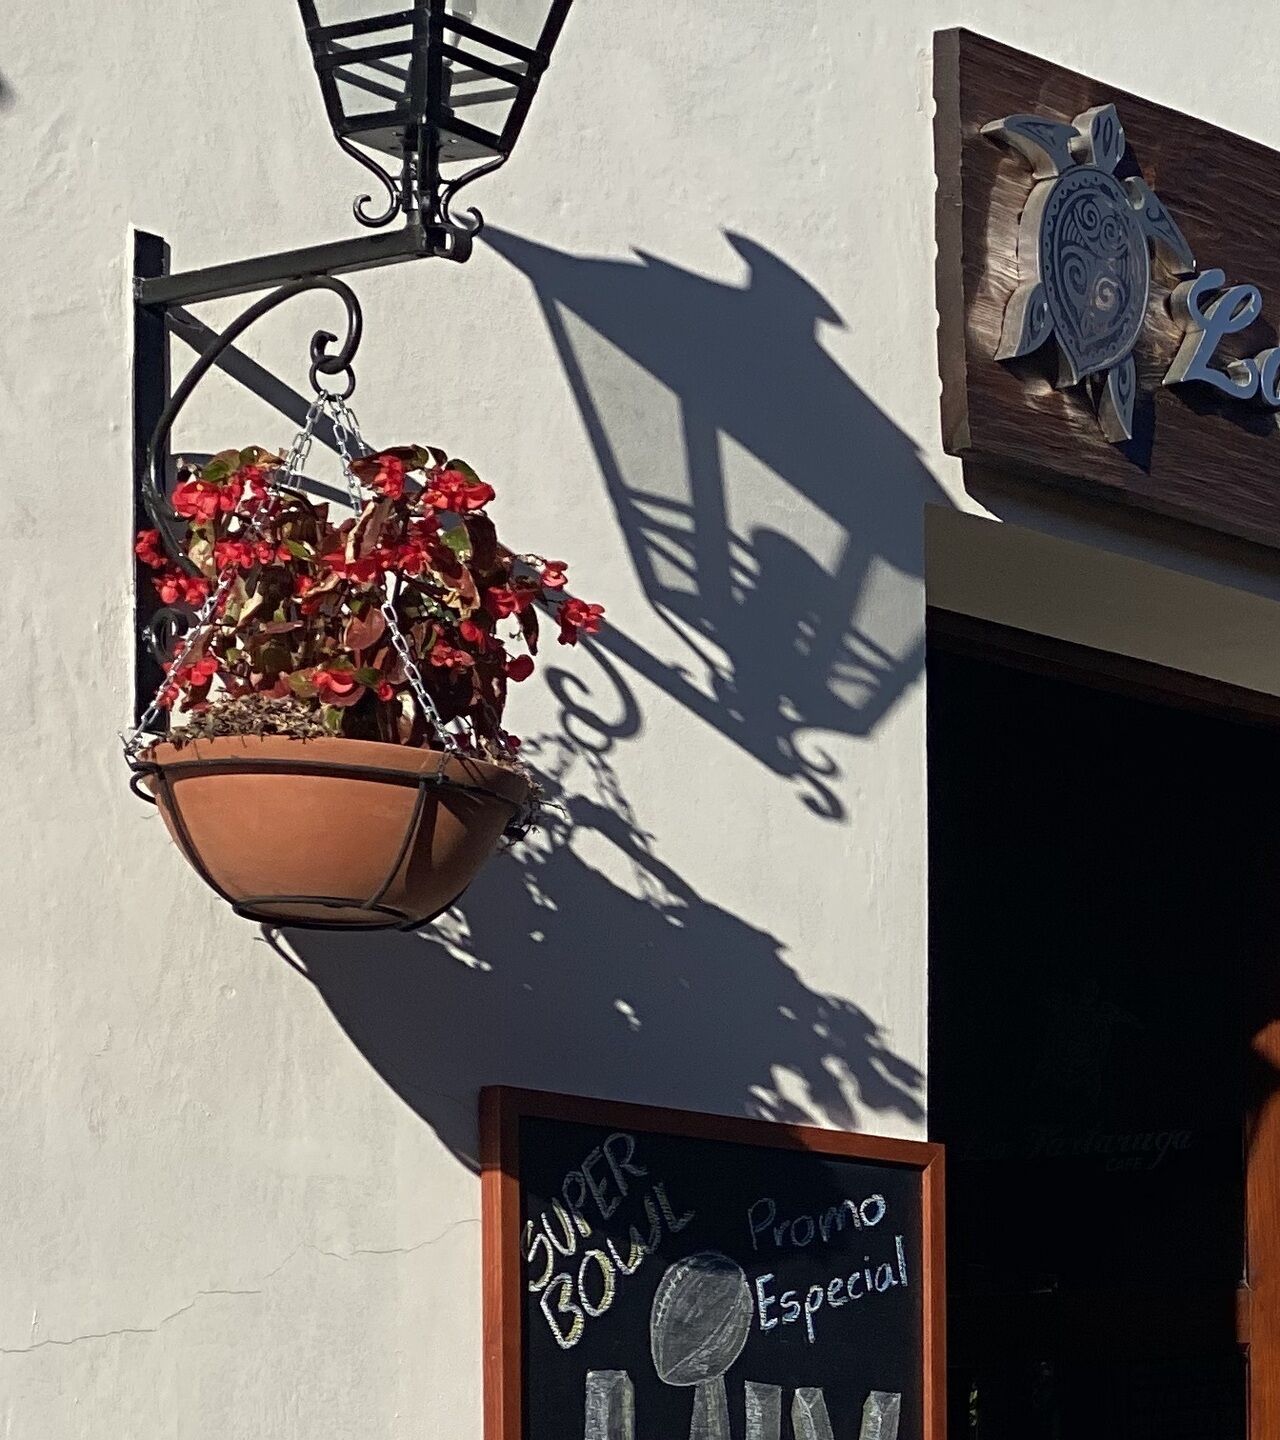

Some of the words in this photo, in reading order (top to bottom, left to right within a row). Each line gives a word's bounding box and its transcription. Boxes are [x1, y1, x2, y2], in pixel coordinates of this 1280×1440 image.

[521, 1131, 649, 1293] SUPER
[540, 1181, 696, 1350] BOWL
[747, 1193, 887, 1251] Promo
[755, 1234, 909, 1344] Especial
